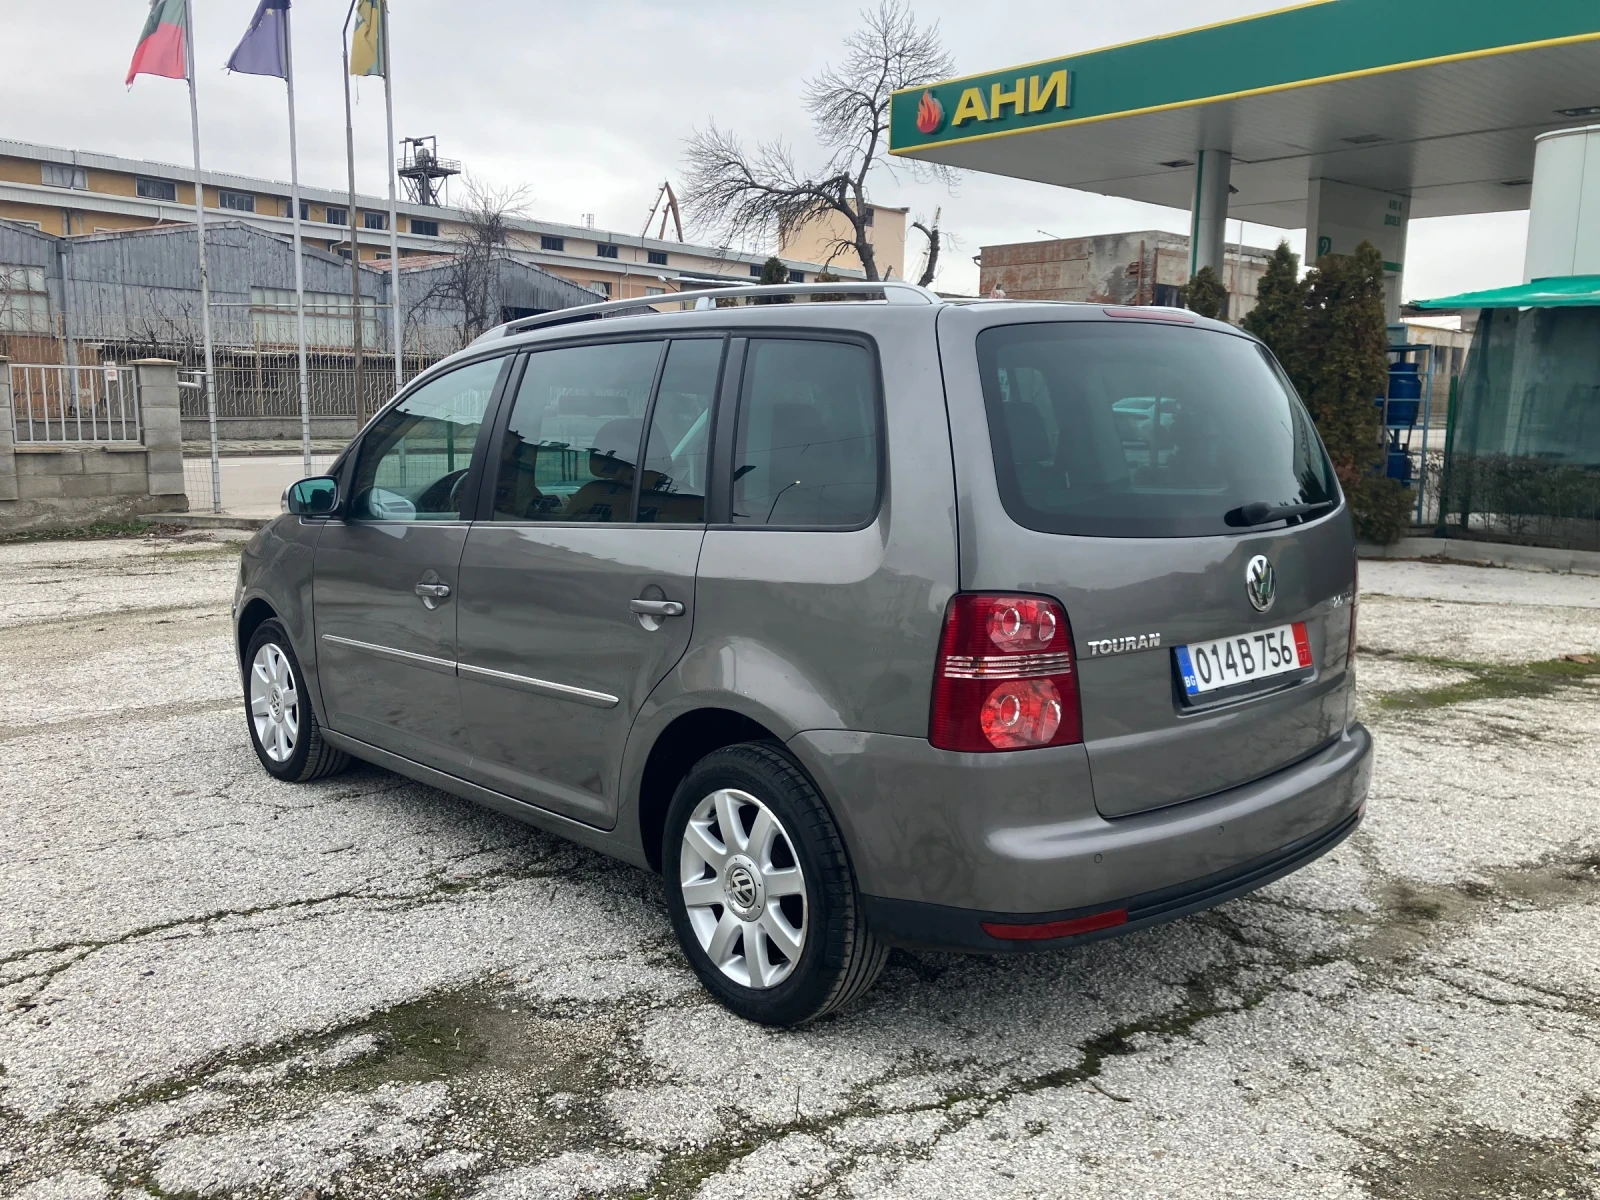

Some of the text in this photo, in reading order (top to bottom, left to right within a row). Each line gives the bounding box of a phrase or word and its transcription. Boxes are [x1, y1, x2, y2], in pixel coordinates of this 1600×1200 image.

[951, 69, 1068, 126] АНИ
[1087, 632, 1161, 656] TOURAN
[1184, 675, 1196, 688] BG
